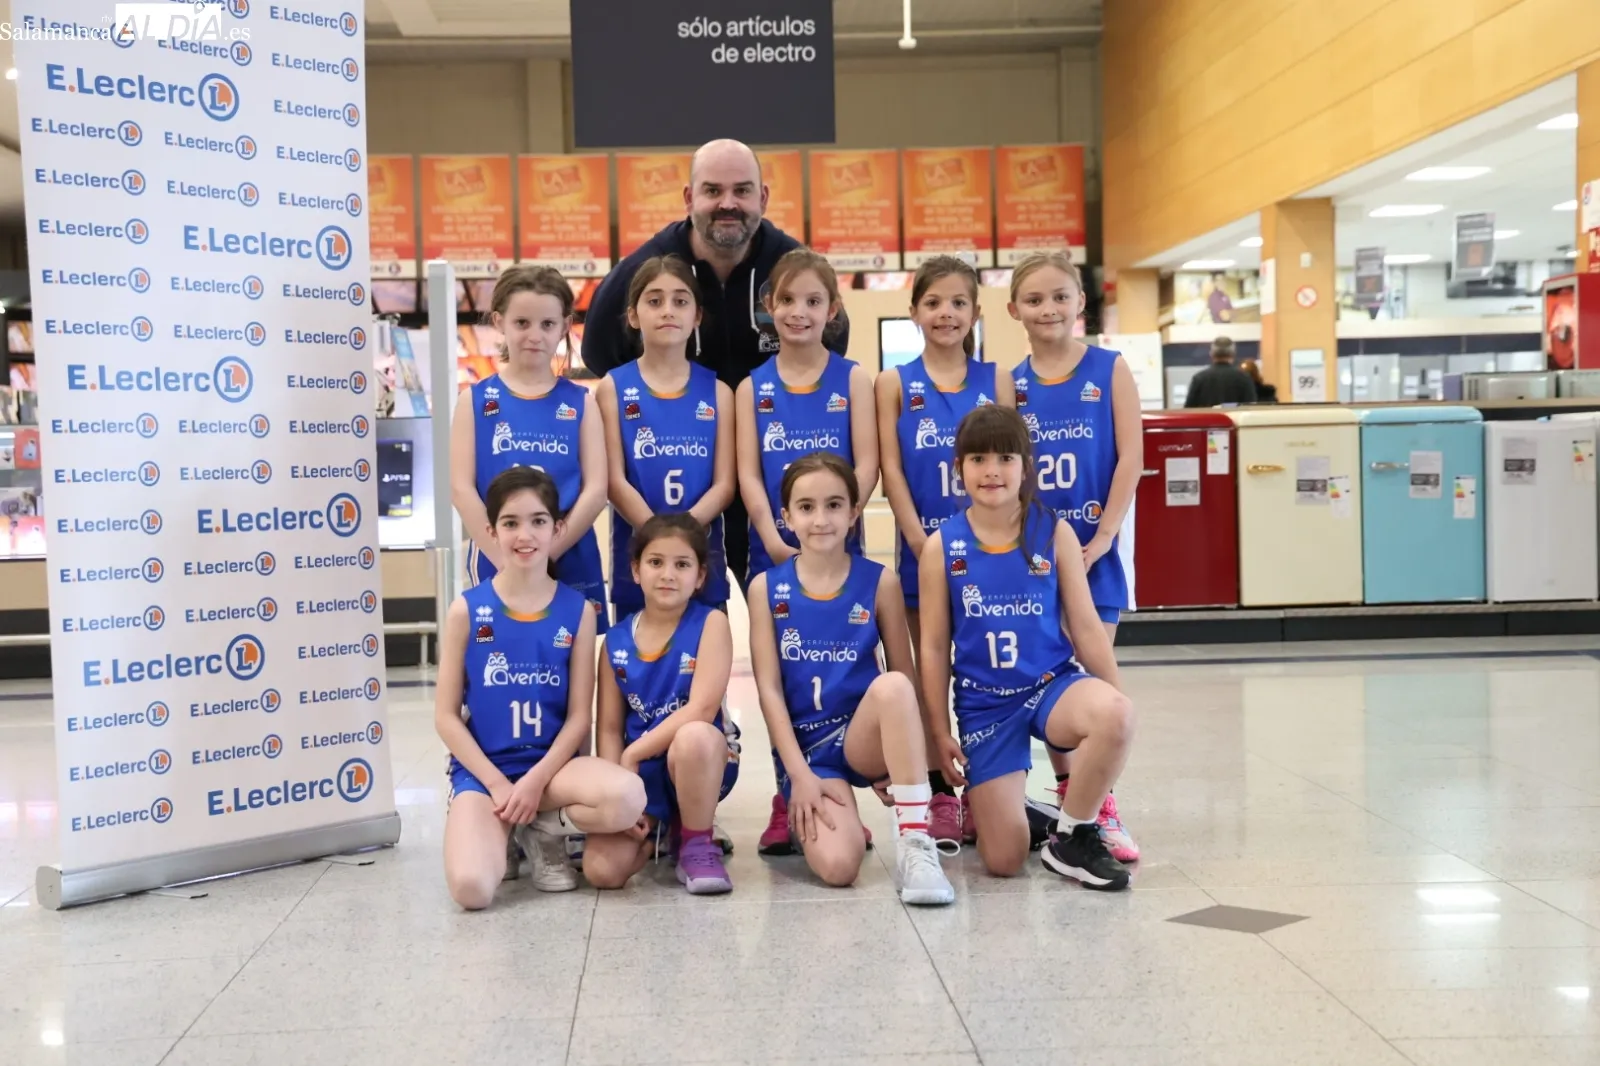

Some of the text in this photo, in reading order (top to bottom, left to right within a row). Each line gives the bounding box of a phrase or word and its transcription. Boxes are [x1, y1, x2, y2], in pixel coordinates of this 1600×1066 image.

[270, 6, 338, 29] E.Leclerc
[677, 15, 816, 37] sólo artículos
[711, 42, 816, 63] de electro
[272, 53, 339, 74] E.Leclerc
[46, 64, 226, 112] E.Leclerc L
[274, 100, 341, 120] E.Leclerc
[32, 118, 115, 139] E.Leclerc
[164, 132, 233, 153] E.Leclerc
[277, 146, 343, 165] E.Leclerc
[35, 169, 119, 188] E.Leclerc
[167, 180, 236, 200] E.Leclerc
[278, 192, 344, 211] E.Leclerc
[39, 219, 123, 237] E.Leclerc
[184, 225, 340, 262] E.Leclerc L
[42, 269, 126, 286] E.Leclerc
[171, 277, 240, 294] E.Leclerc
[283, 284, 348, 300] E.Leclerc
[45, 320, 128, 335] E.Leclerc
[174, 325, 243, 340] E.Leclerc
[285, 330, 347, 345] E.Leclerc
[68, 364, 240, 394] E.Leclerc L
[287, 375, 348, 389] E.Leclerc
[52, 419, 133, 433] E.Leclerc
[179, 420, 247, 433] E.Leclerc
[289, 421, 350, 433] E.Leclerc
[55, 469, 136, 483] E.Leclerc
[180, 467, 249, 480] E.Leclerc
[291, 466, 352, 478] E.Leclerc
[1038, 452, 1077, 490] 20
[664, 469, 685, 506] 6
[57, 518, 138, 533] E.Leclerc
[198, 501, 350, 533] E.Leclerc L
[184, 561, 253, 575] E.Leclerc
[295, 555, 357, 569] E.Leclerc
[60, 567, 140, 583] E.Leclerc
[186, 607, 255, 622] E.Leclerc
[296, 599, 359, 614] E.Leclerc
[63, 616, 142, 632] E.Leclerc
[298, 643, 361, 659] E.Leclerc
[985, 630, 1018, 668] 13
[84, 643, 253, 686] E.Leclerc L
[300, 688, 362, 704] E.Leclerc
[811, 676, 823, 711] 1
[191, 699, 258, 717] E.Leclerc
[68, 712, 144, 731] E.Leclerc
[509, 700, 542, 738] 14
[301, 732, 364, 749] E.Leclerc
[192, 745, 260, 764] E.Leclerc
[70, 761, 146, 781] E.Leclerc
[208, 767, 361, 816] E.Leclerc L
[72, 810, 149, 831] E.Leclerc
